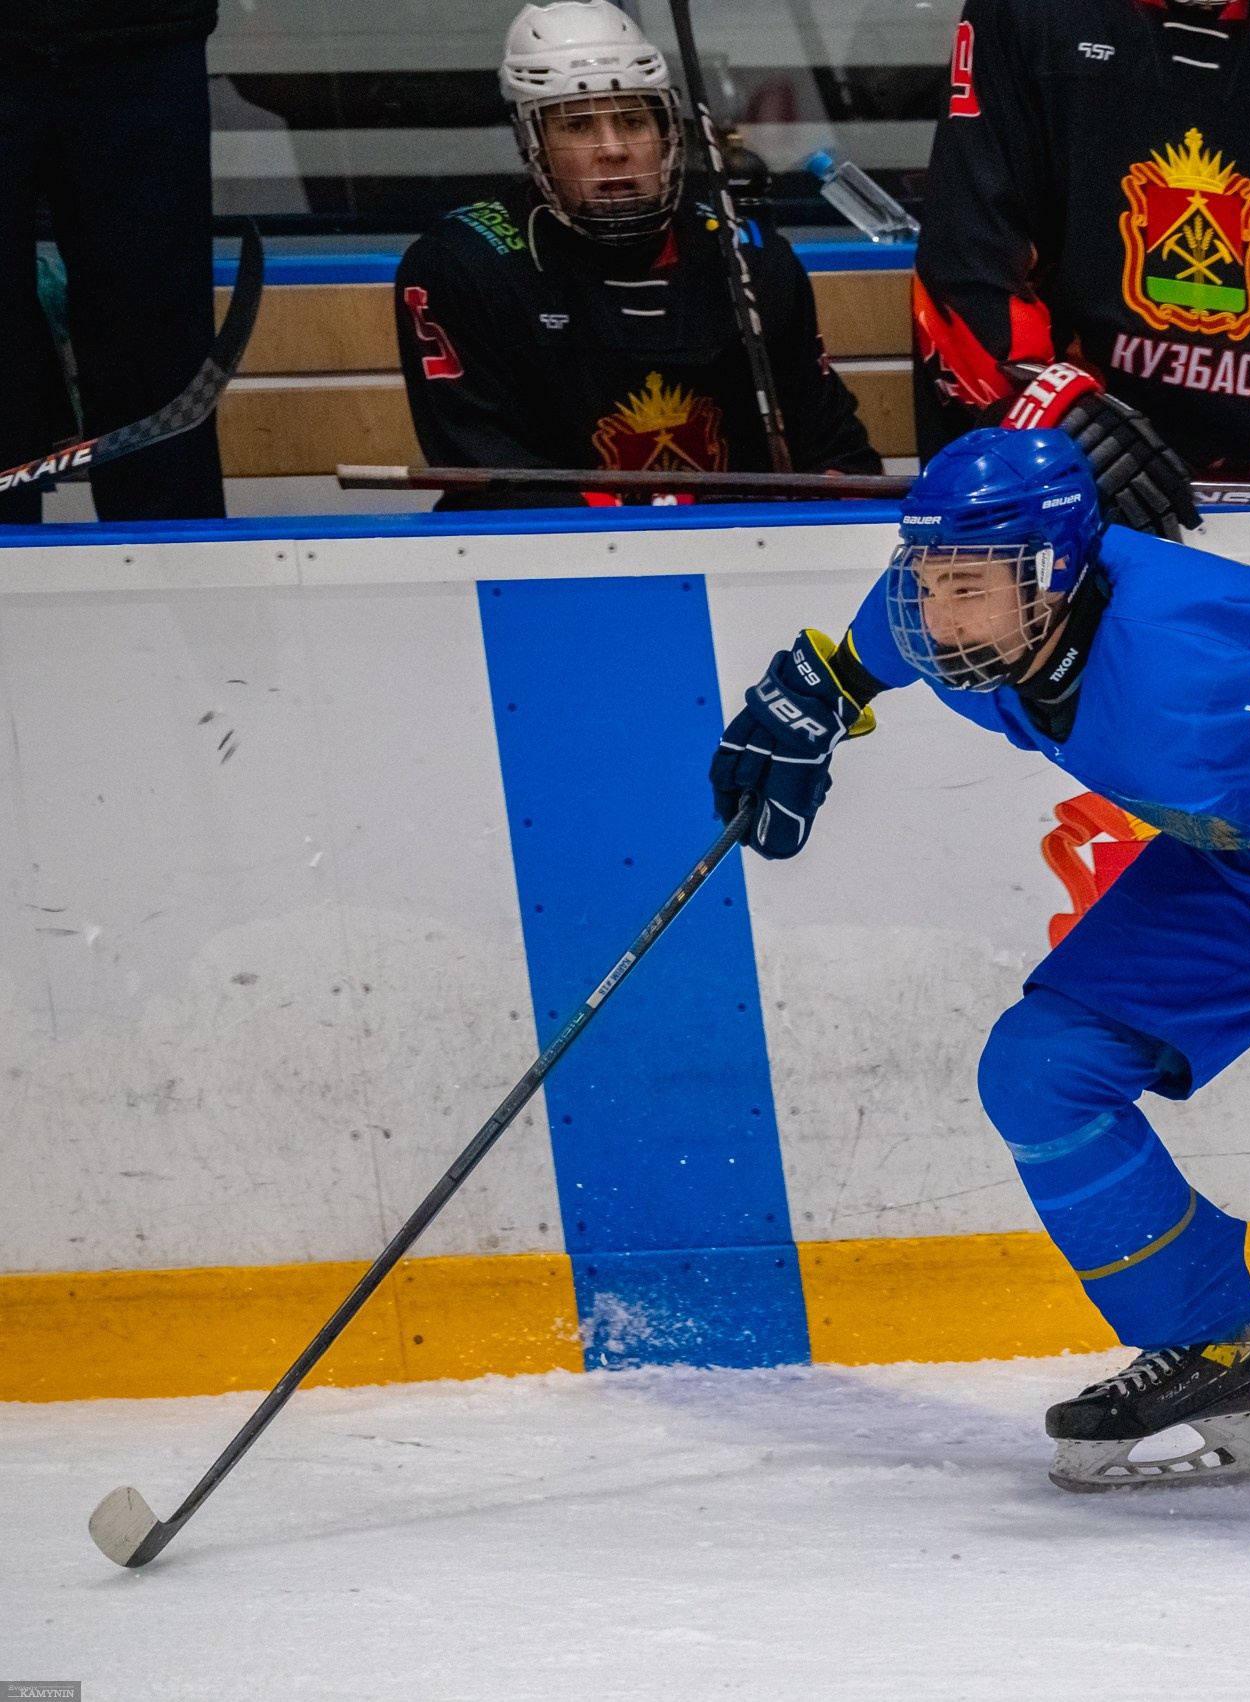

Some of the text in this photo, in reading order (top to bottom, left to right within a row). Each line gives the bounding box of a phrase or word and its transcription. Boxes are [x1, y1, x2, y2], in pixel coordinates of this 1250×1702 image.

[1042, 493, 1082, 510] BAUER
[902, 515, 942, 525] BAUER
[793, 649, 821, 686] S29
[1049, 647, 1079, 683] TIXON
[755, 676, 829, 743] UER
[610, 956, 632, 982] KARIM
